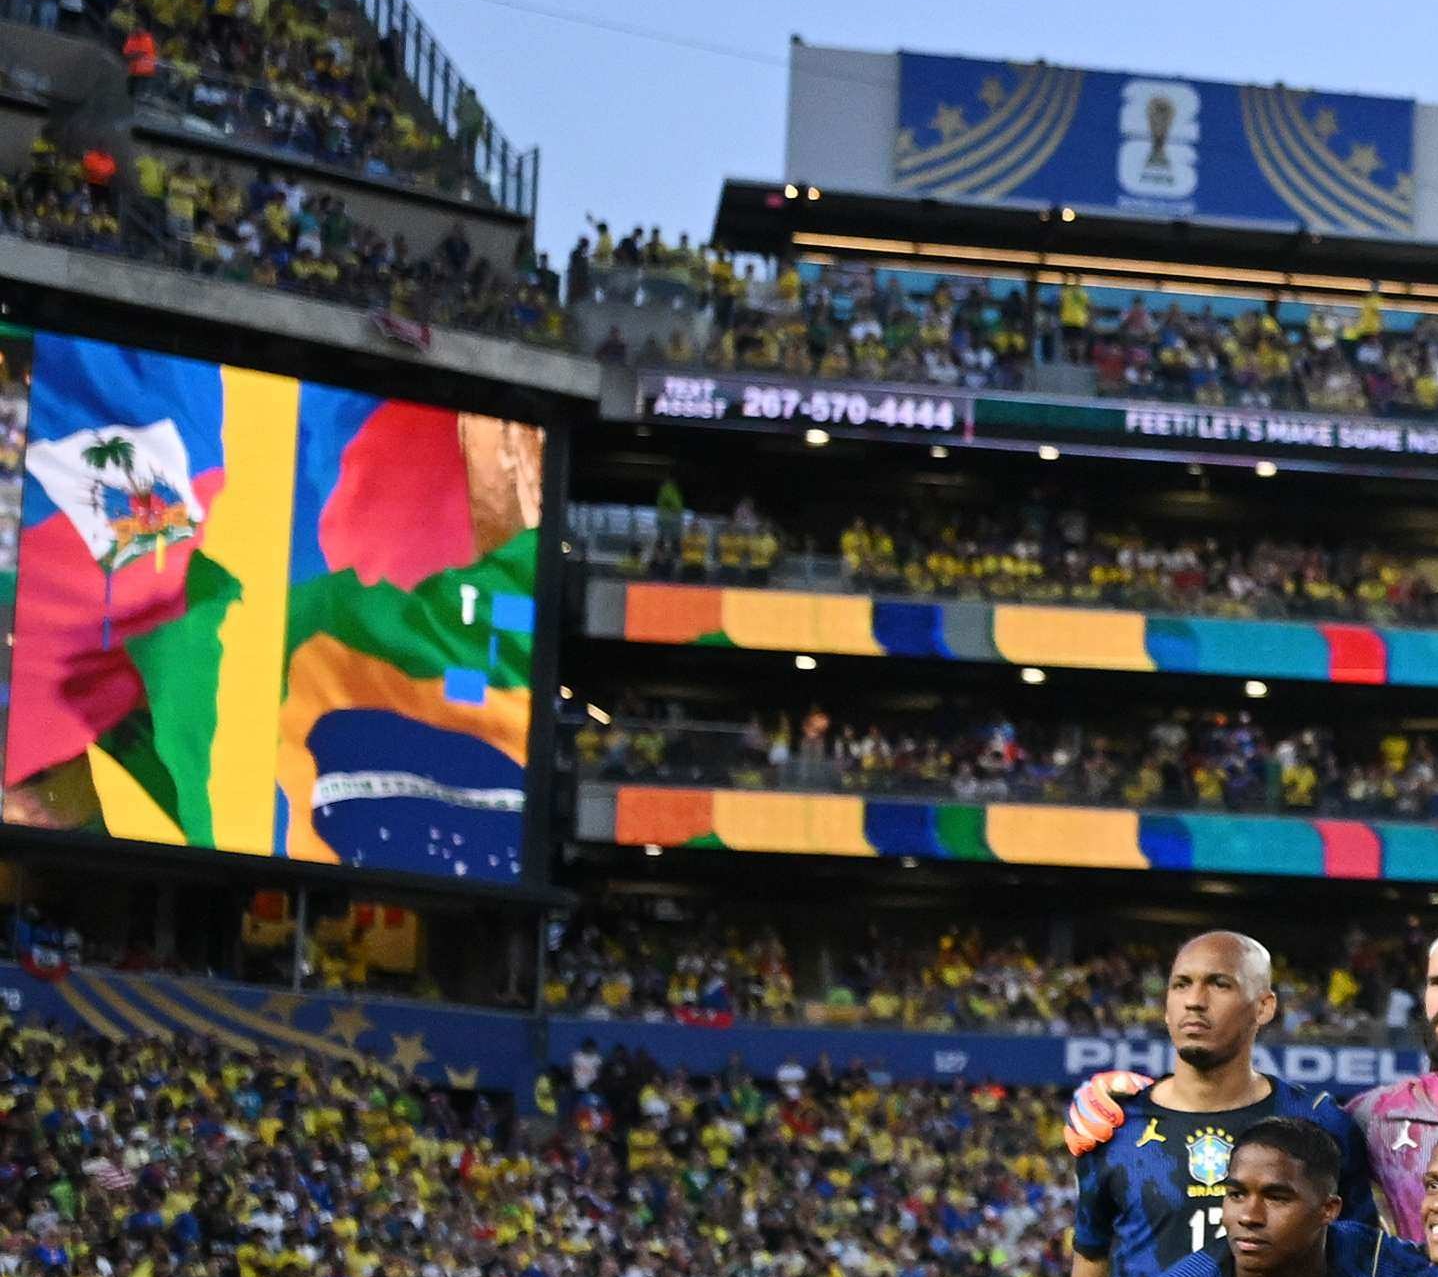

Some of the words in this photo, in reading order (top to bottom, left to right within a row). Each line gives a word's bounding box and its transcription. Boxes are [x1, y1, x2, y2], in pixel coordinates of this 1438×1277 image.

[742, 386, 955, 431] 267-570-4444
[1266, 418, 1333, 447] MAKE
[1338, 423, 1401, 452] SOME
